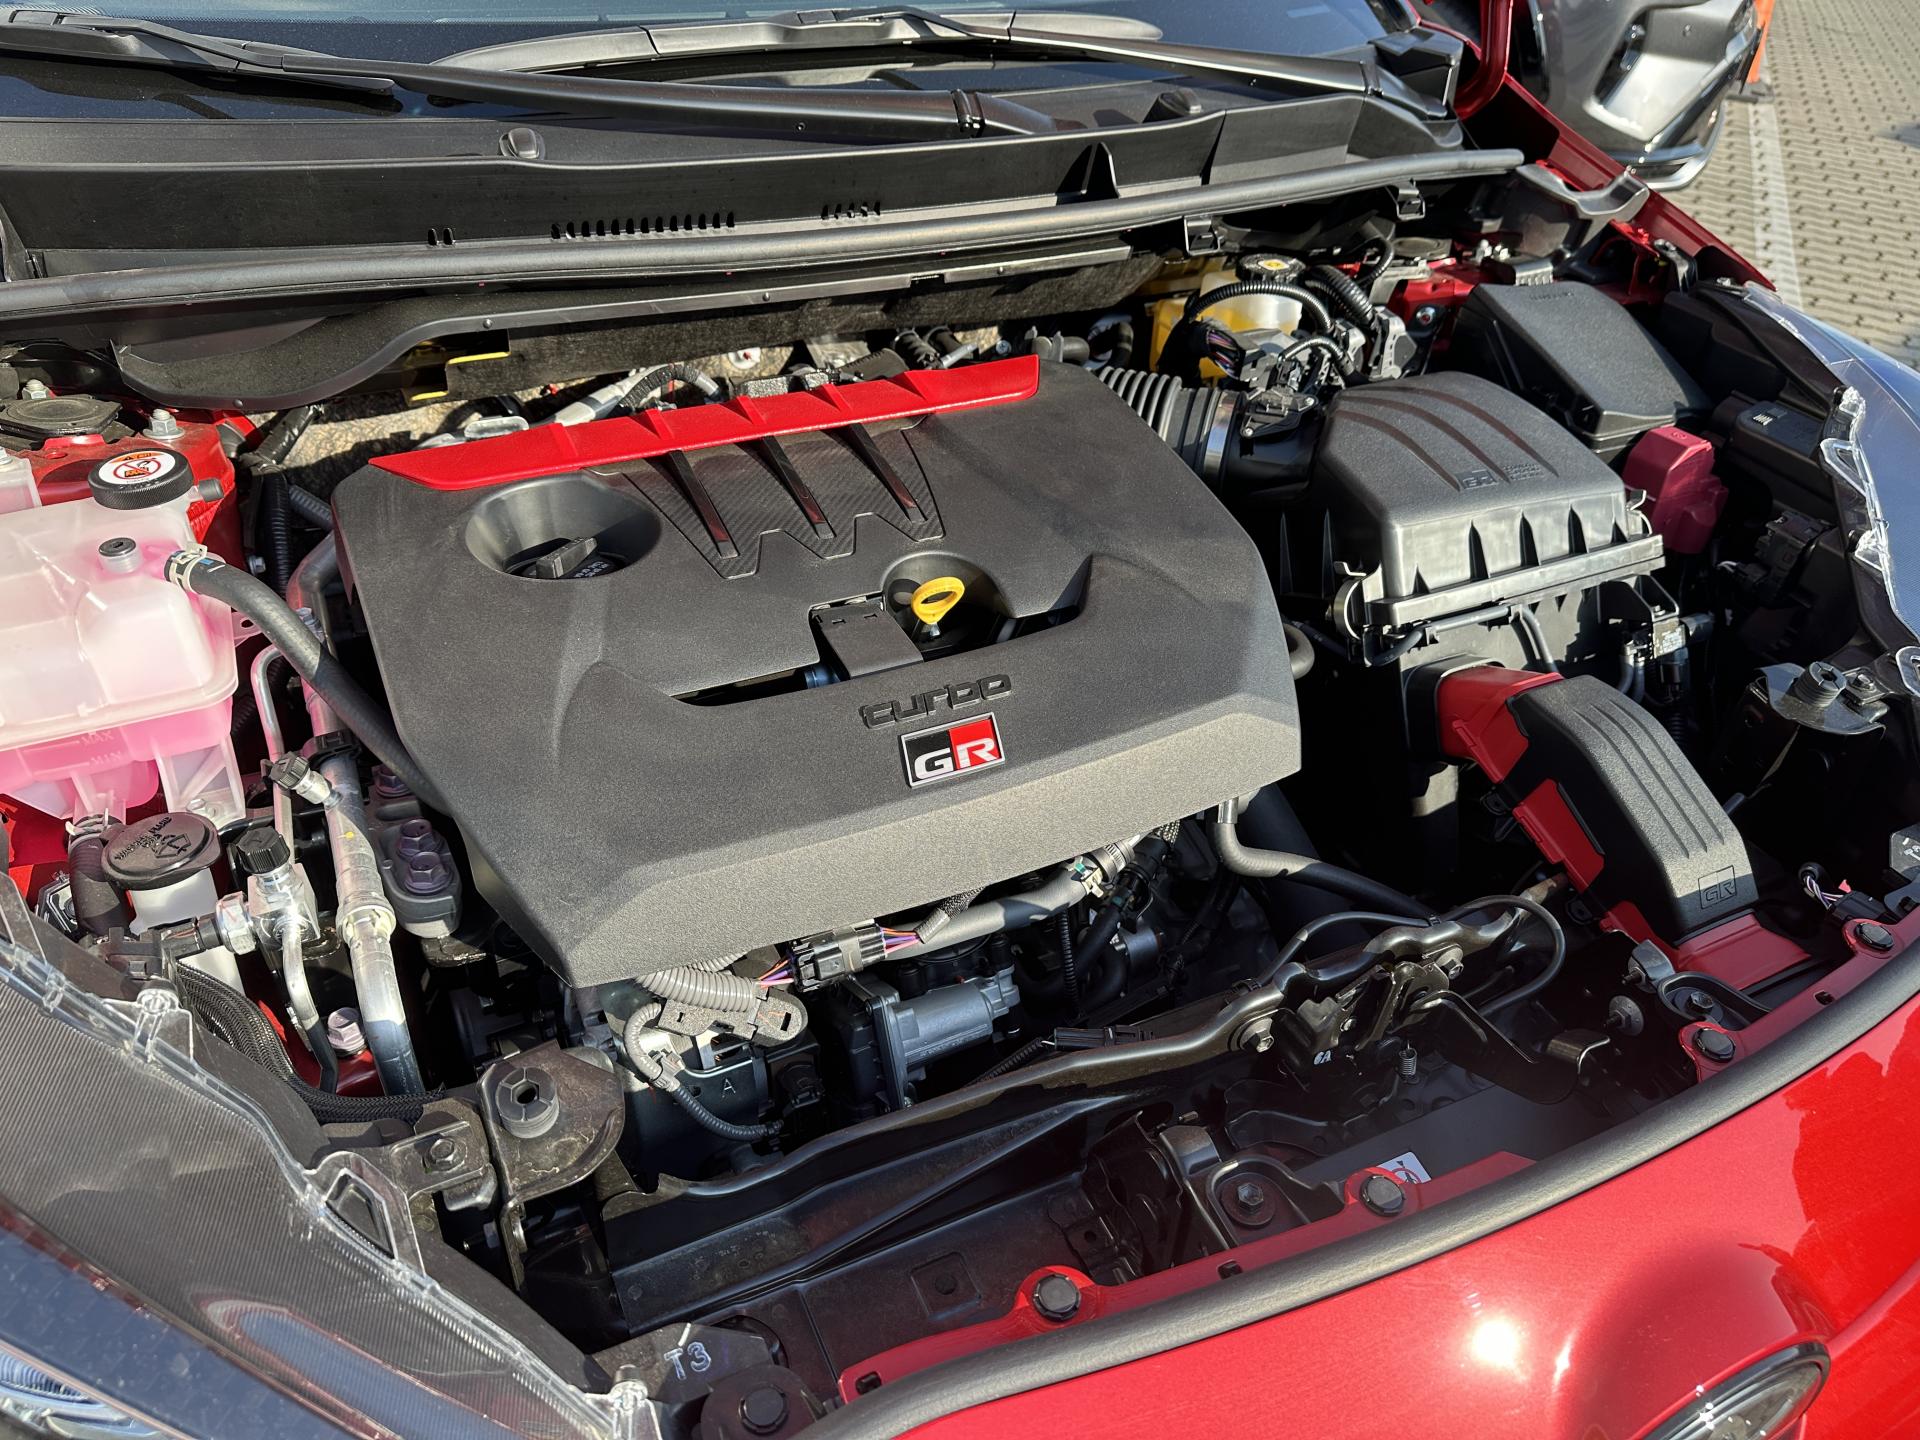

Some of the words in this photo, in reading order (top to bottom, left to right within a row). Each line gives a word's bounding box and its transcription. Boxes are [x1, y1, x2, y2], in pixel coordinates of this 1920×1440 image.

[858, 674, 1012, 730] turbo
[914, 737, 998, 780] GR
[722, 1078, 736, 1098] A
[664, 1341, 712, 1380] T3
